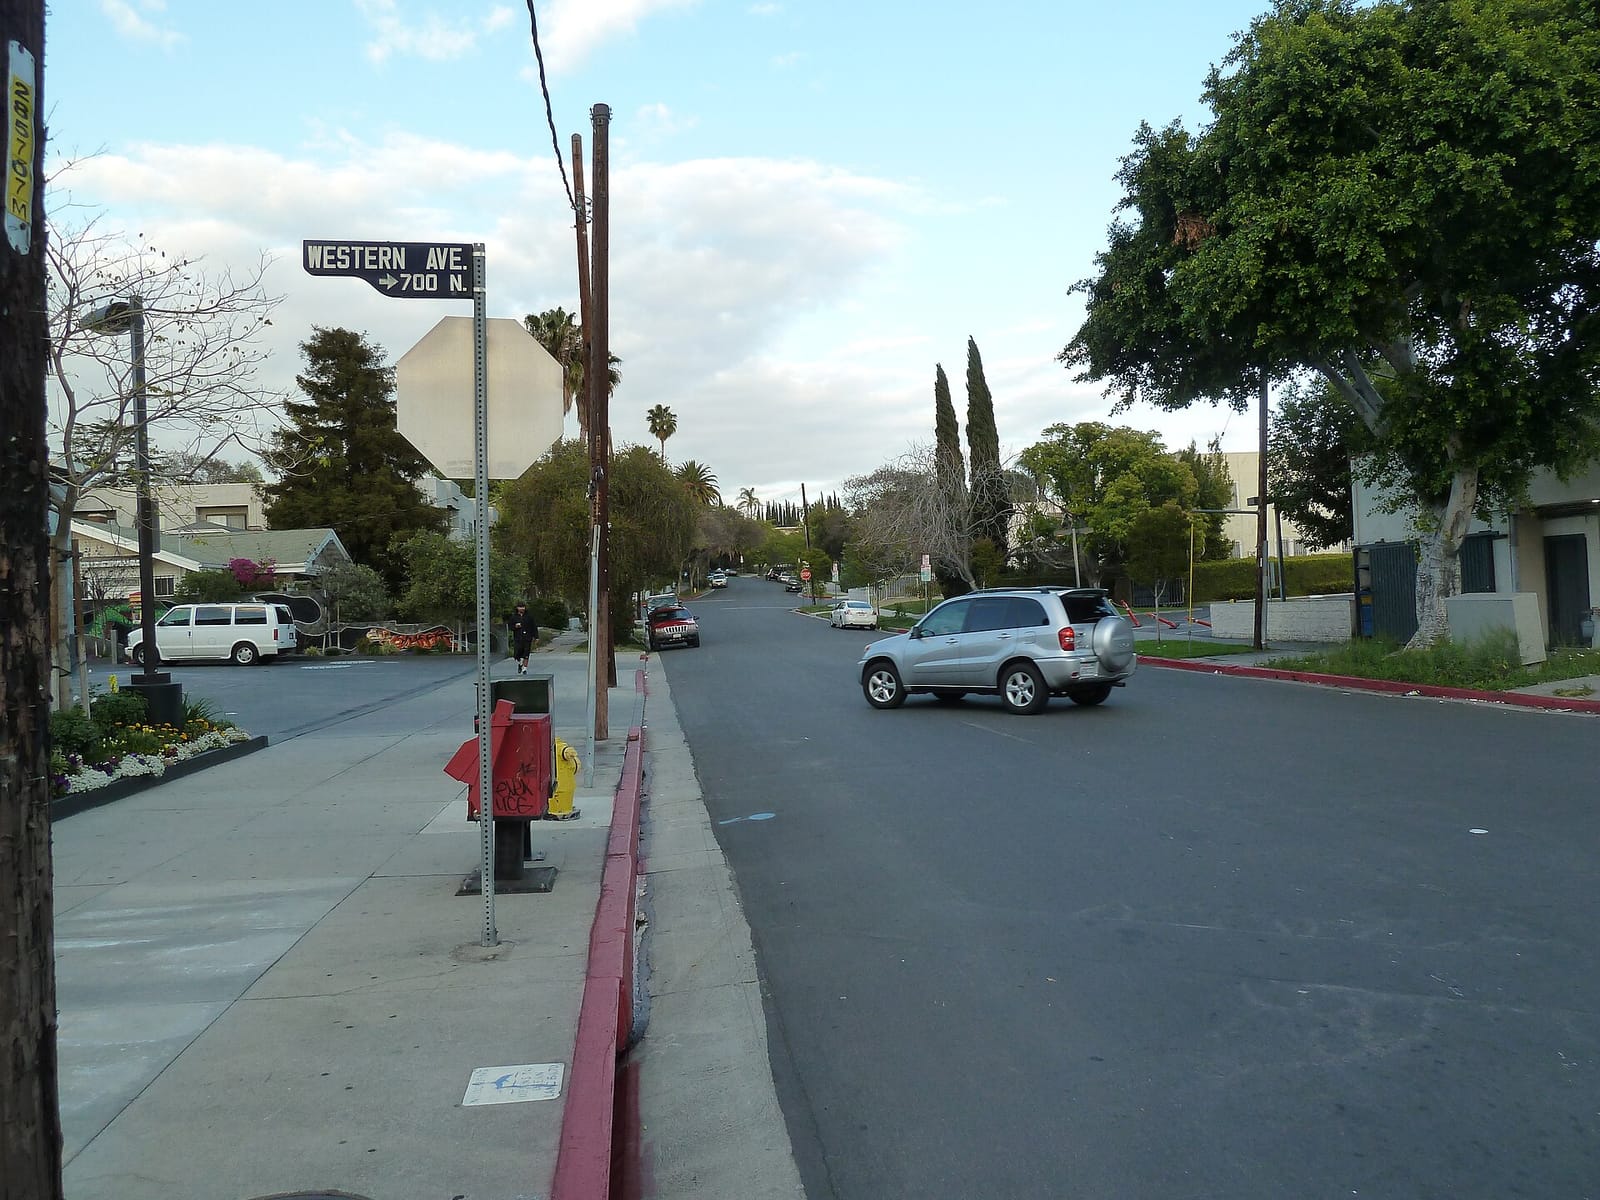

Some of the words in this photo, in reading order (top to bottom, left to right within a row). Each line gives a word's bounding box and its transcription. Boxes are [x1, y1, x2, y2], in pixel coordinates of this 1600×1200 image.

[307, 245, 406, 270] WESTERN
[426, 247, 468, 271] AVE.
[400, 273, 438, 292] 700
[449, 274, 468, 292] N.
